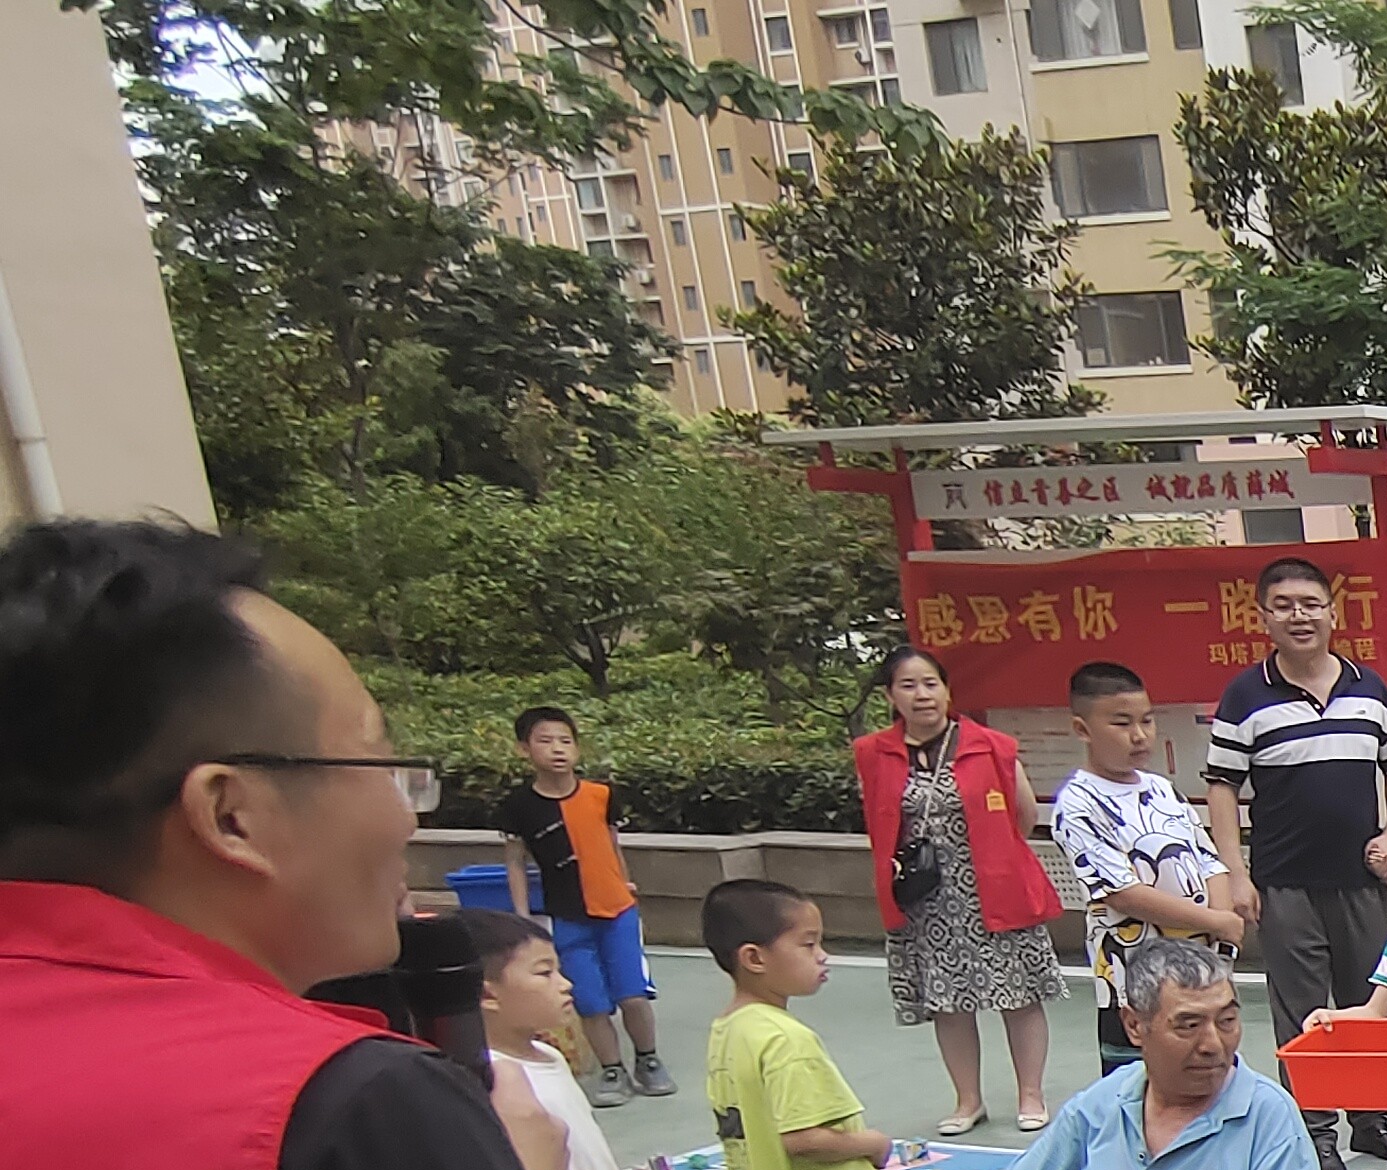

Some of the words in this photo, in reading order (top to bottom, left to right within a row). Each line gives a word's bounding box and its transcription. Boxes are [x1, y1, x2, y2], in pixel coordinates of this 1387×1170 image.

[917, 584, 1120, 648] 感恩有你
[1163, 572, 1379, 635] 一路行
